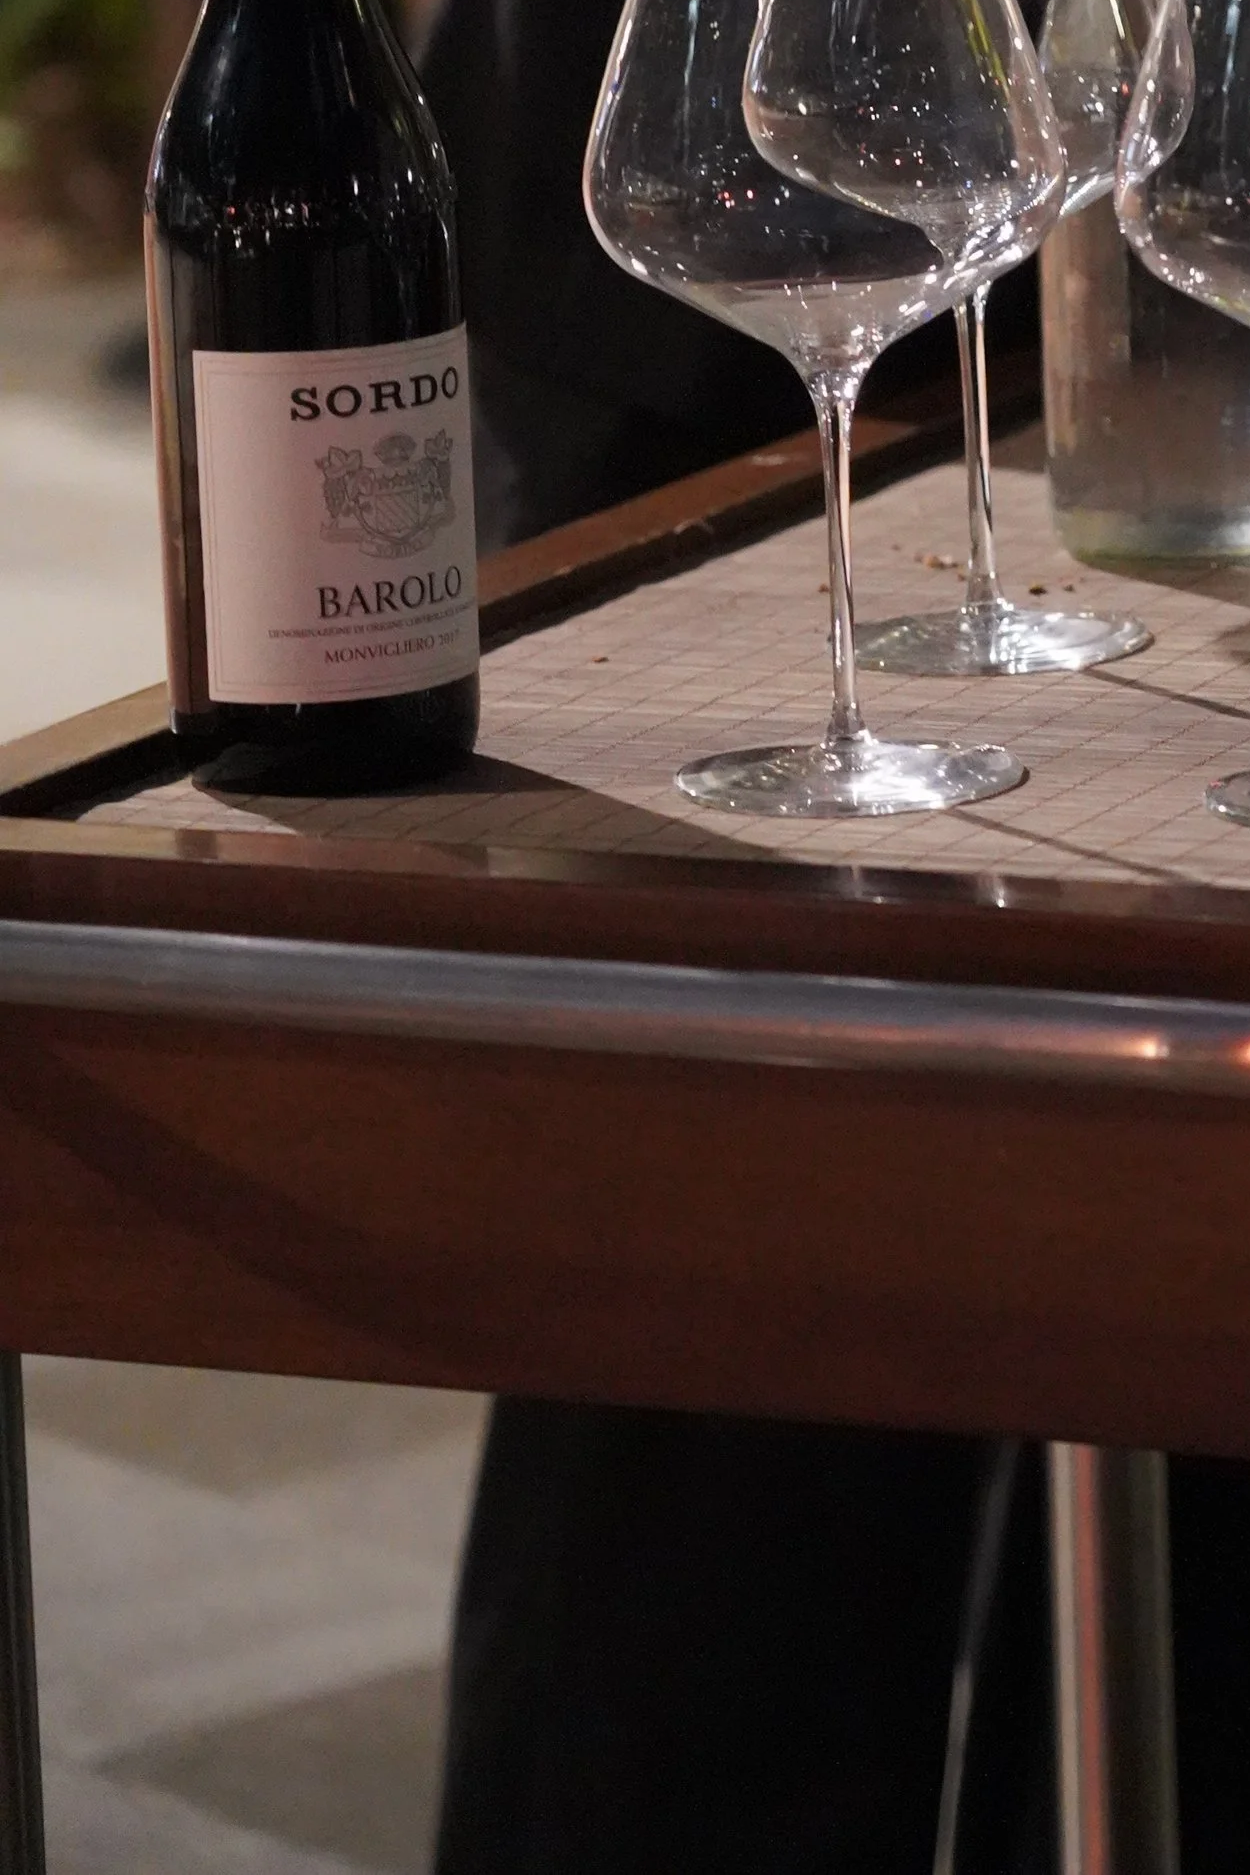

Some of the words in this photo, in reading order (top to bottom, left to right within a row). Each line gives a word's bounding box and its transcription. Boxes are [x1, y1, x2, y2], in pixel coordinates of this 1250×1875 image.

[290, 365, 459, 421] SORDO
[316, 565, 462, 619] BAROLO
[324, 636, 435, 664] MONVIGLIERO
